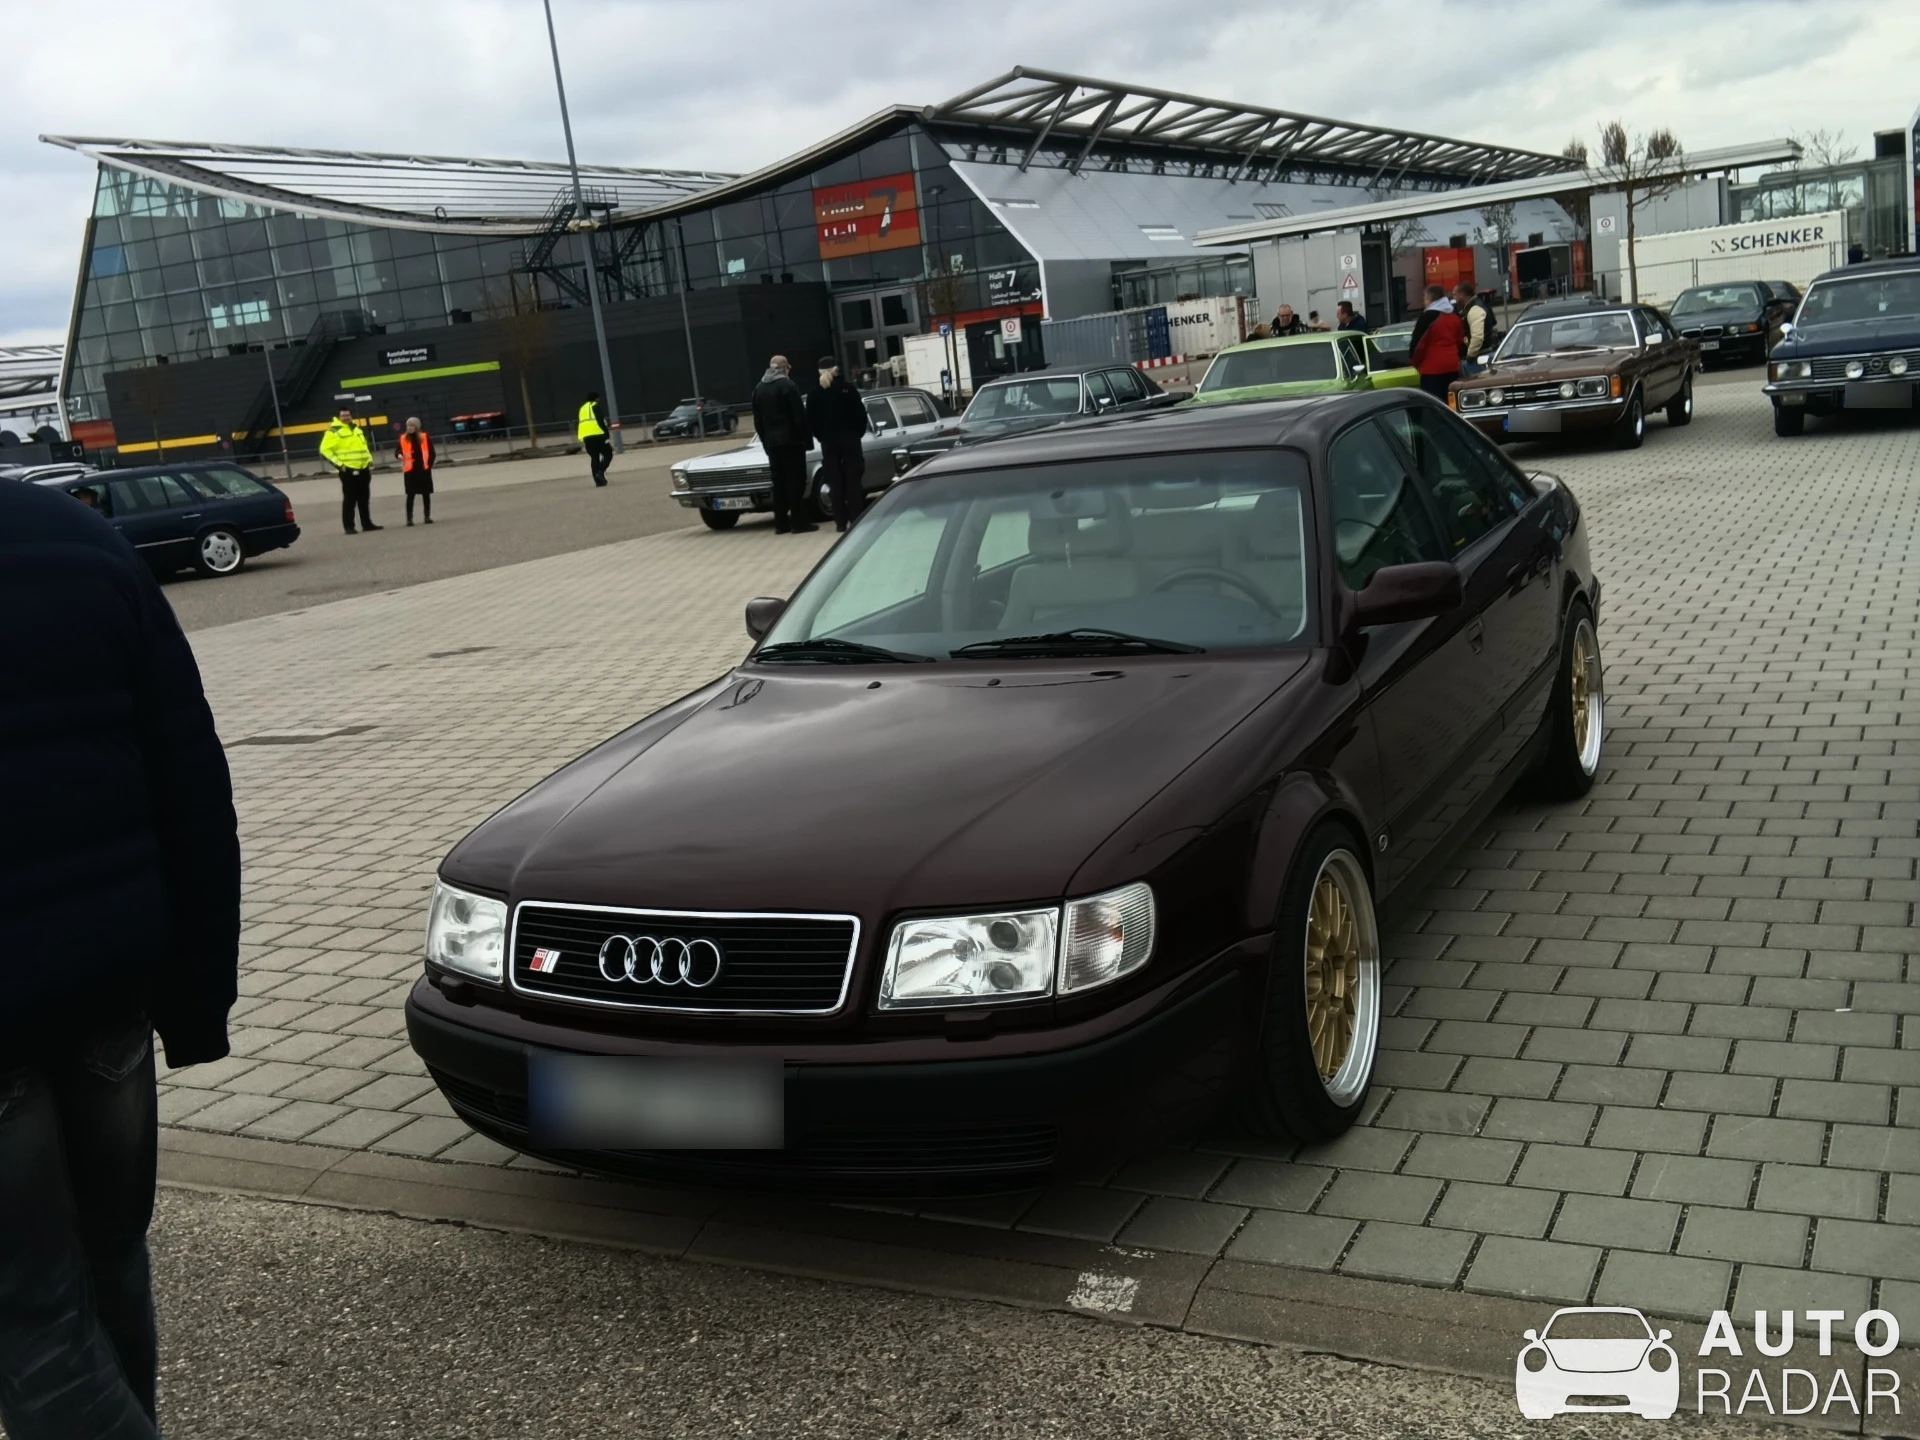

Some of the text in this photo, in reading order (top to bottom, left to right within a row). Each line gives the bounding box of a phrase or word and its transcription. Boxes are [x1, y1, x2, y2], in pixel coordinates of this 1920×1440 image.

[821, 188, 897, 238] Halle 7
[824, 223, 857, 246] Hall
[1730, 226, 1824, 252] SCHENKER
[1792, 242, 1825, 252] Logistics
[1425, 256, 1439, 267] 7.1
[988, 270, 1016, 287] Halle 7
[990, 281, 1003, 290] Hall
[75, 396, 81, 409] 7
